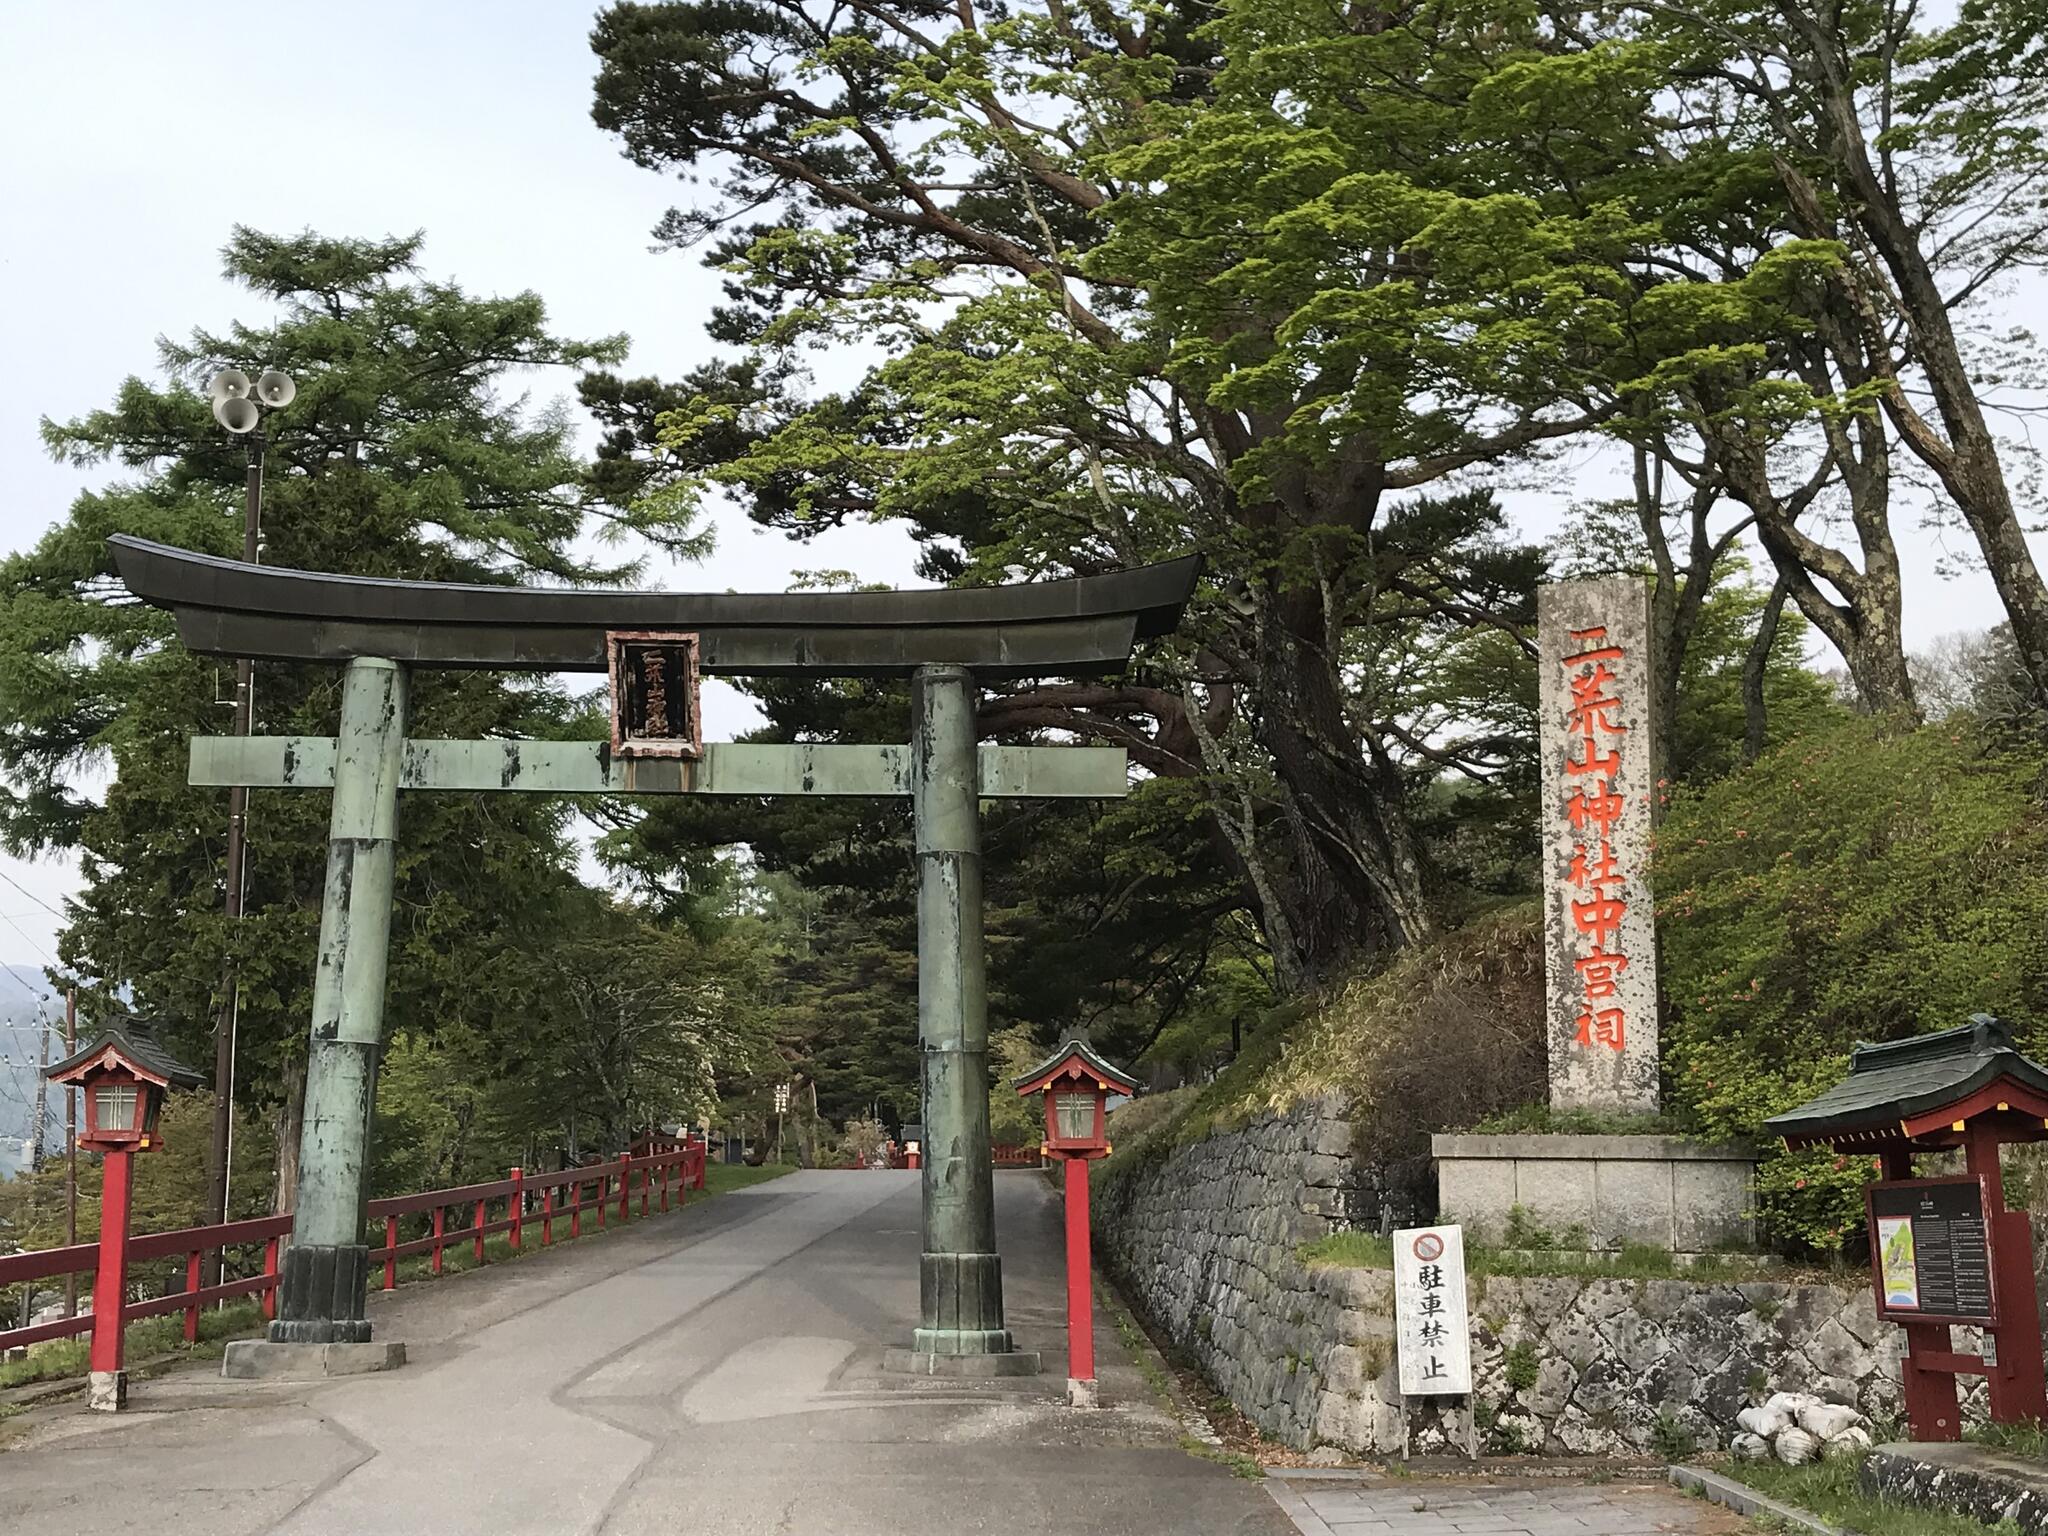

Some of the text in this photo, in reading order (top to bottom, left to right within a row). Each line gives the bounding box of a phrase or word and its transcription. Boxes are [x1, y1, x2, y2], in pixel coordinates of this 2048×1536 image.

[1562, 626, 1628, 1051] 二荒山神社中宮祠
[1418, 1265, 1449, 1380] 駐車禁止
